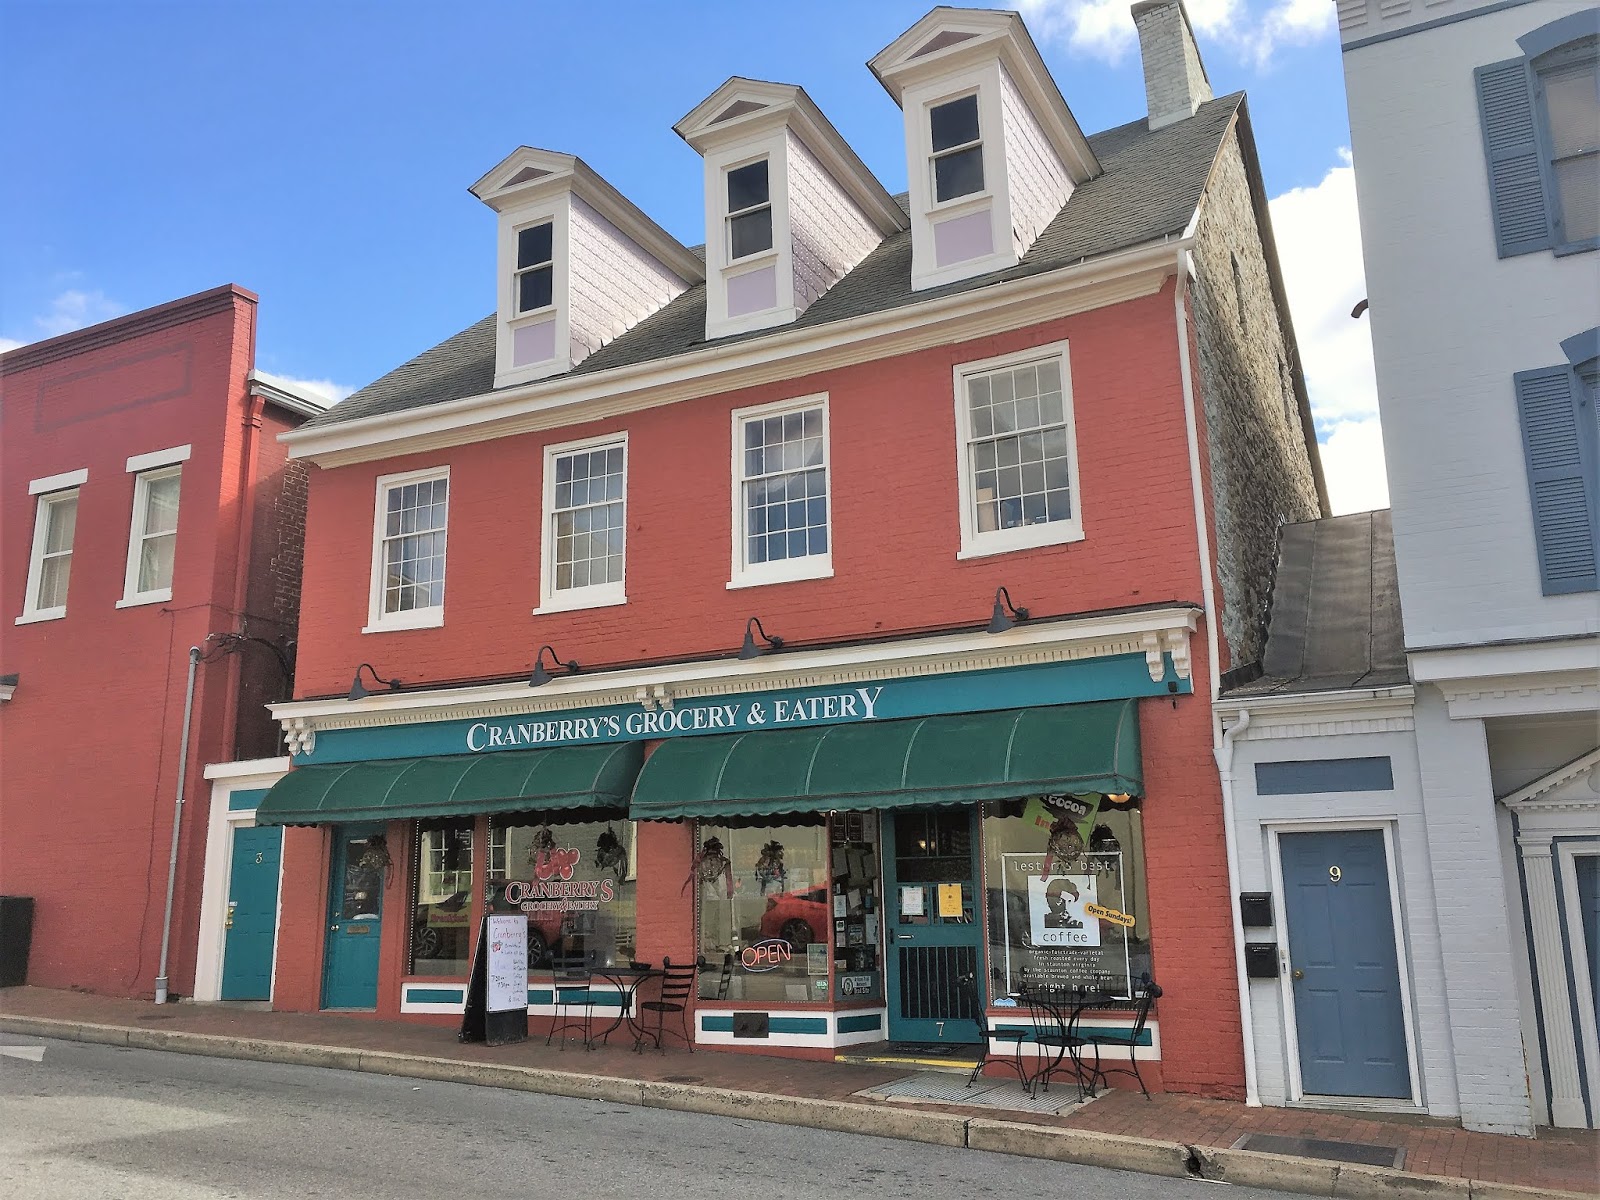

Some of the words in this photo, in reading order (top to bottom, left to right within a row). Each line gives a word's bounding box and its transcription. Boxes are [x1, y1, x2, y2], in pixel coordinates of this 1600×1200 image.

[466, 714, 620, 752] CRANBERRY'S
[626, 704, 741, 735] GROCERY
[747, 702, 766, 725] &
[774, 687, 884, 723] EATERY
[255, 852, 263, 864] 3
[1329, 865, 1342, 882] 9
[520, 901, 560, 911] GROCERY
[1088, 905, 1105, 916] Open
[1105, 910, 1132, 924] Sundays!
[1042, 931, 1088, 942] coffee
[742, 944, 791, 966] OPEN
[1038, 982, 1066, 993] right
[1072, 983, 1100, 993] hre!
[936, 1022, 945, 1037] 7
